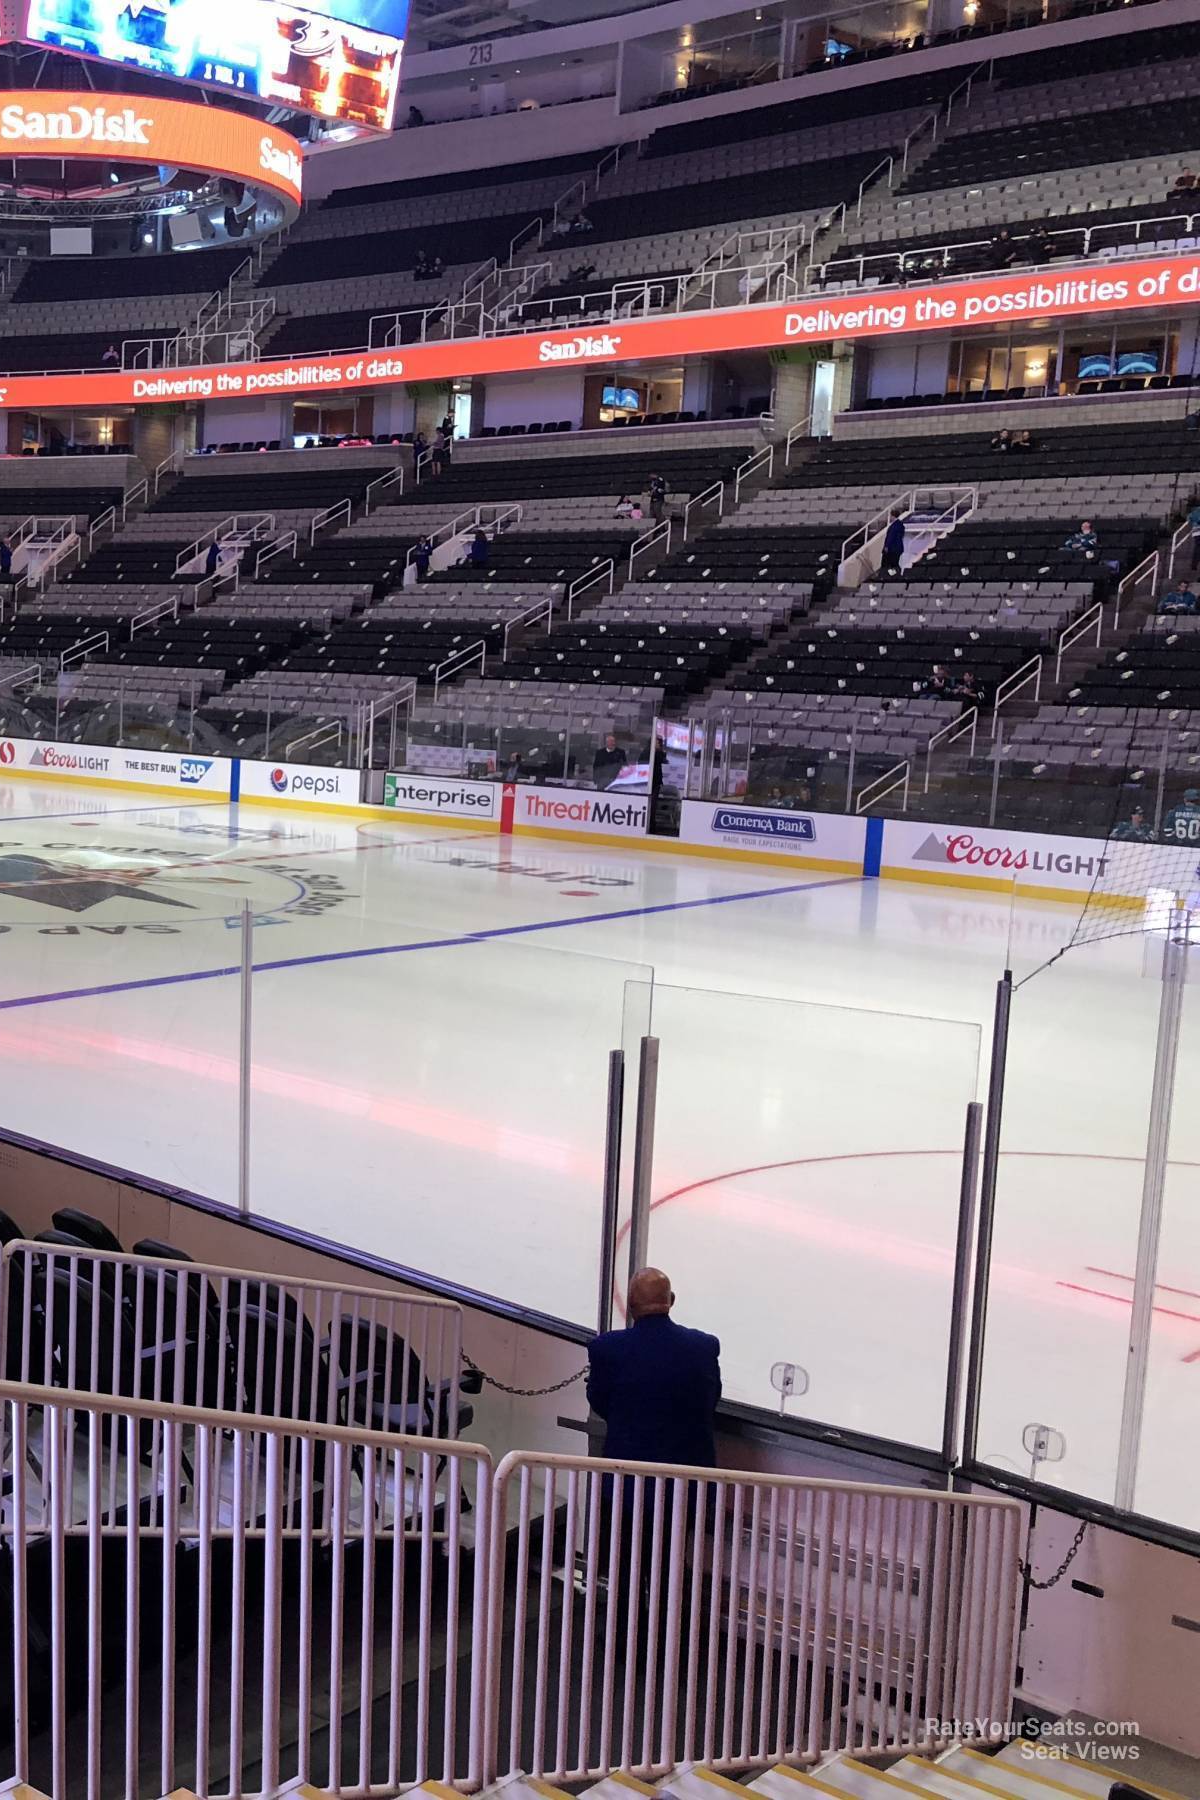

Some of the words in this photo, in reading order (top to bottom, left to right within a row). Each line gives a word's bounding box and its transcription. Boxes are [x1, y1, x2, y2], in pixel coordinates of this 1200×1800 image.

[469, 43, 492, 66] 213
[0, 105, 151, 143] SanDisk
[786, 304, 906, 335] Delivering
[915, 298, 955, 320] the
[964, 278, 1127, 320] possibilities
[1137, 270, 1171, 297] of
[539, 335, 619, 361] SanDisk
[133, 377, 212, 398] Delivering
[217, 375, 242, 391] the
[247, 367, 342, 389] possibilities
[346, 362, 362, 379] of
[366, 360, 403, 376] data
[43, 747, 78, 769] Coors
[79, 757, 110, 772] LIGHT
[125, 760, 141, 770] THE
[141, 762, 160, 773] BEST
[161, 764, 177, 774] RUN
[181, 762, 206, 780] SAP
[292, 775, 340, 795] pepsi
[776, 820, 807, 834] Bank
[946, 834, 1029, 870] Coors
[1032, 851, 1110, 877] LIGHT
[38, 924, 181, 936] SAP
